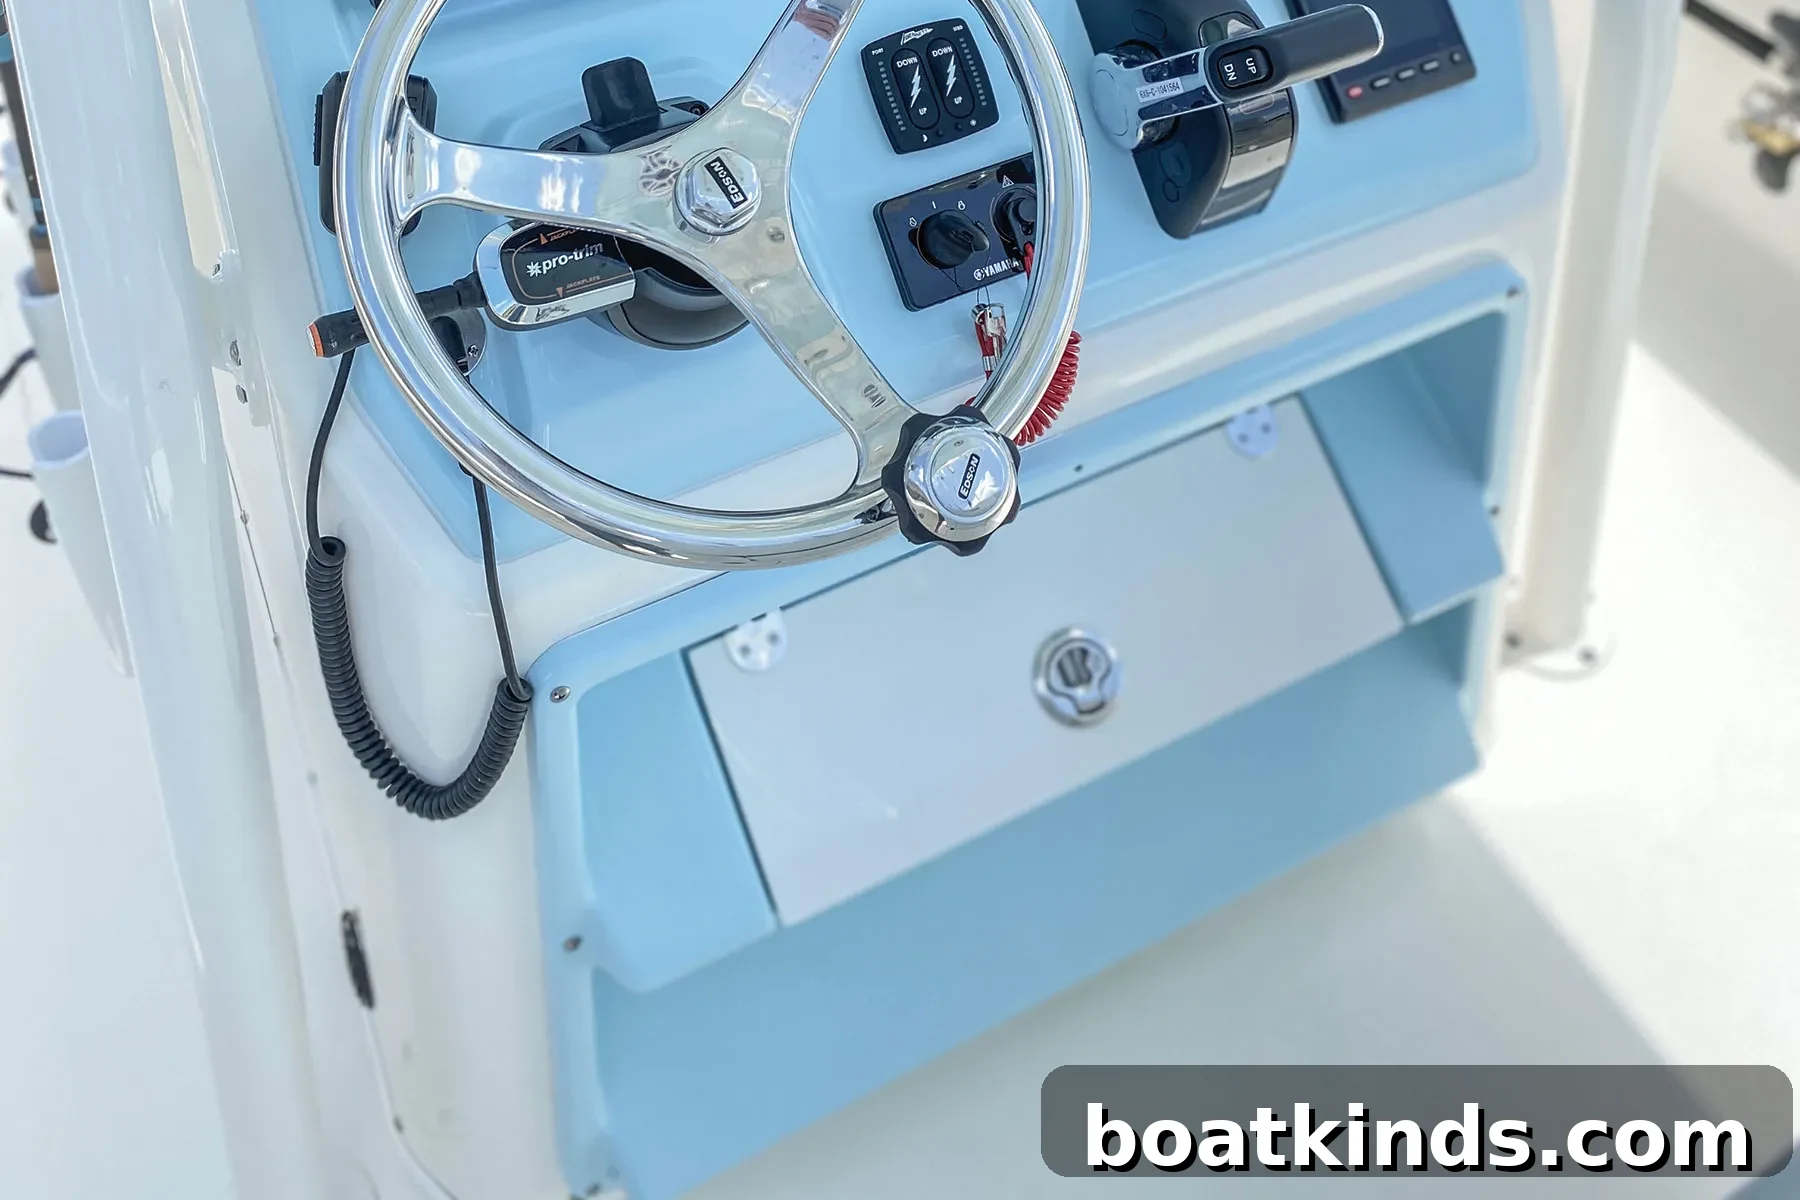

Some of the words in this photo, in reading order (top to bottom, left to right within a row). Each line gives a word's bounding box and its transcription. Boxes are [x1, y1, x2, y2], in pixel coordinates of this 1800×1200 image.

[932, 46, 953, 57] DOWN
[896, 56, 918, 68] DOWN
[1245, 57, 1257, 74] UP
[1224, 63, 1238, 81] DN
[954, 96, 963, 104] UP
[918, 107, 928, 115] UP
[710, 161, 745, 204] EDSON
[542, 243, 603, 275] pro-trim
[983, 257, 1020, 277] YAMAHA
[960, 455, 979, 497] EDSON
